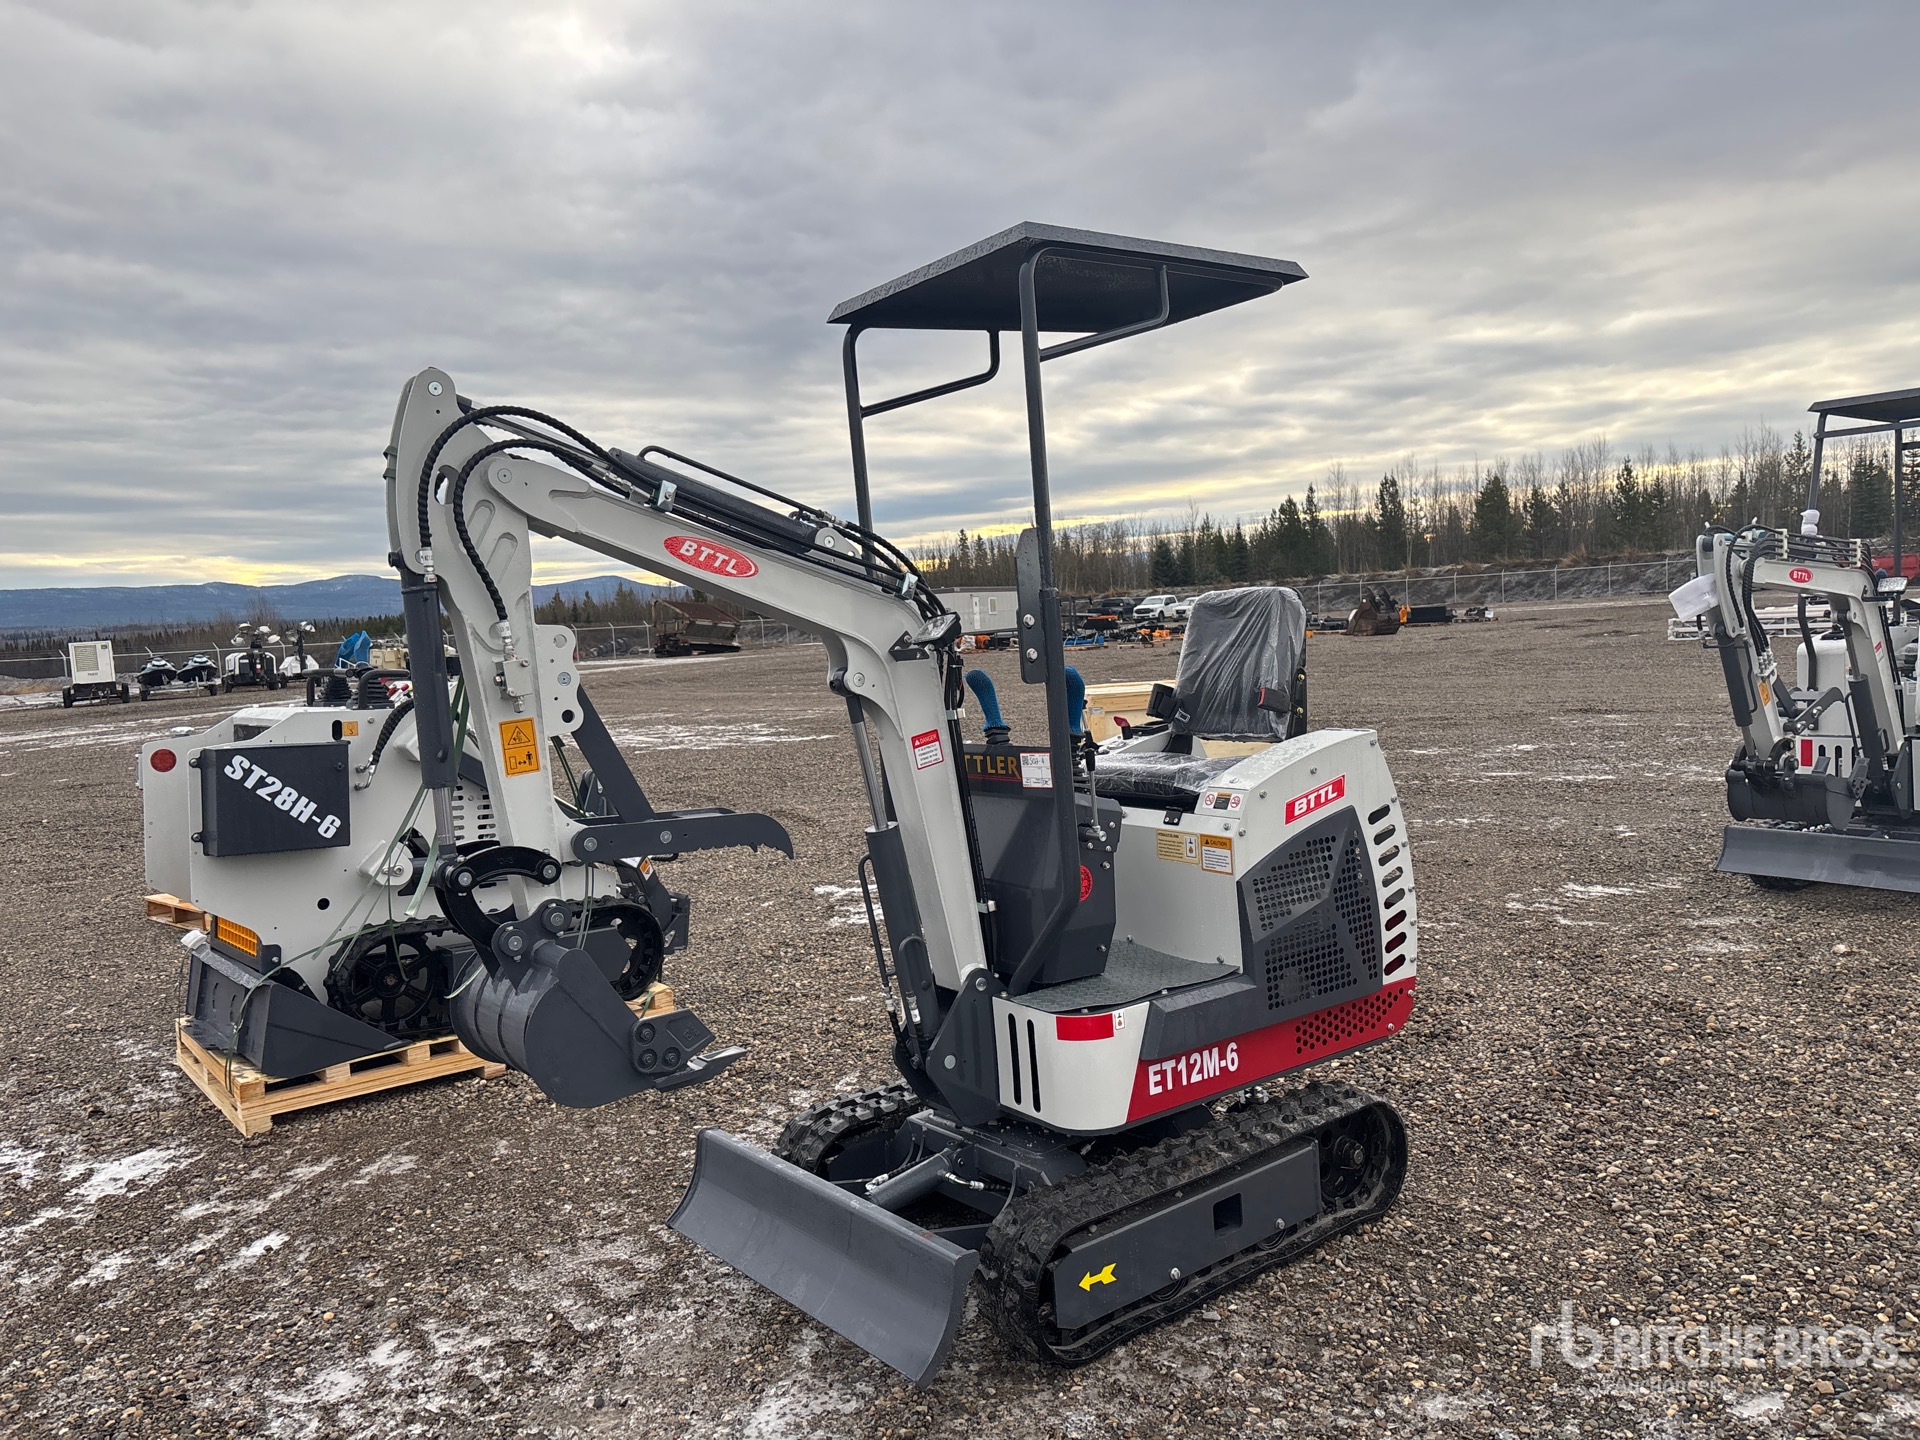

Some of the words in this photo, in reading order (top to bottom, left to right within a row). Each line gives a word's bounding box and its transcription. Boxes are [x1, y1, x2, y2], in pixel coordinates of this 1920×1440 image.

[680, 540, 738, 575] BTTL
[1793, 570, 1809, 581] BTTL
[920, 733, 937, 744] DANGER
[223, 754, 342, 839] ST28H-6
[1294, 784, 1338, 817] BTTL
[1148, 1041, 1239, 1096] ET12M-6
